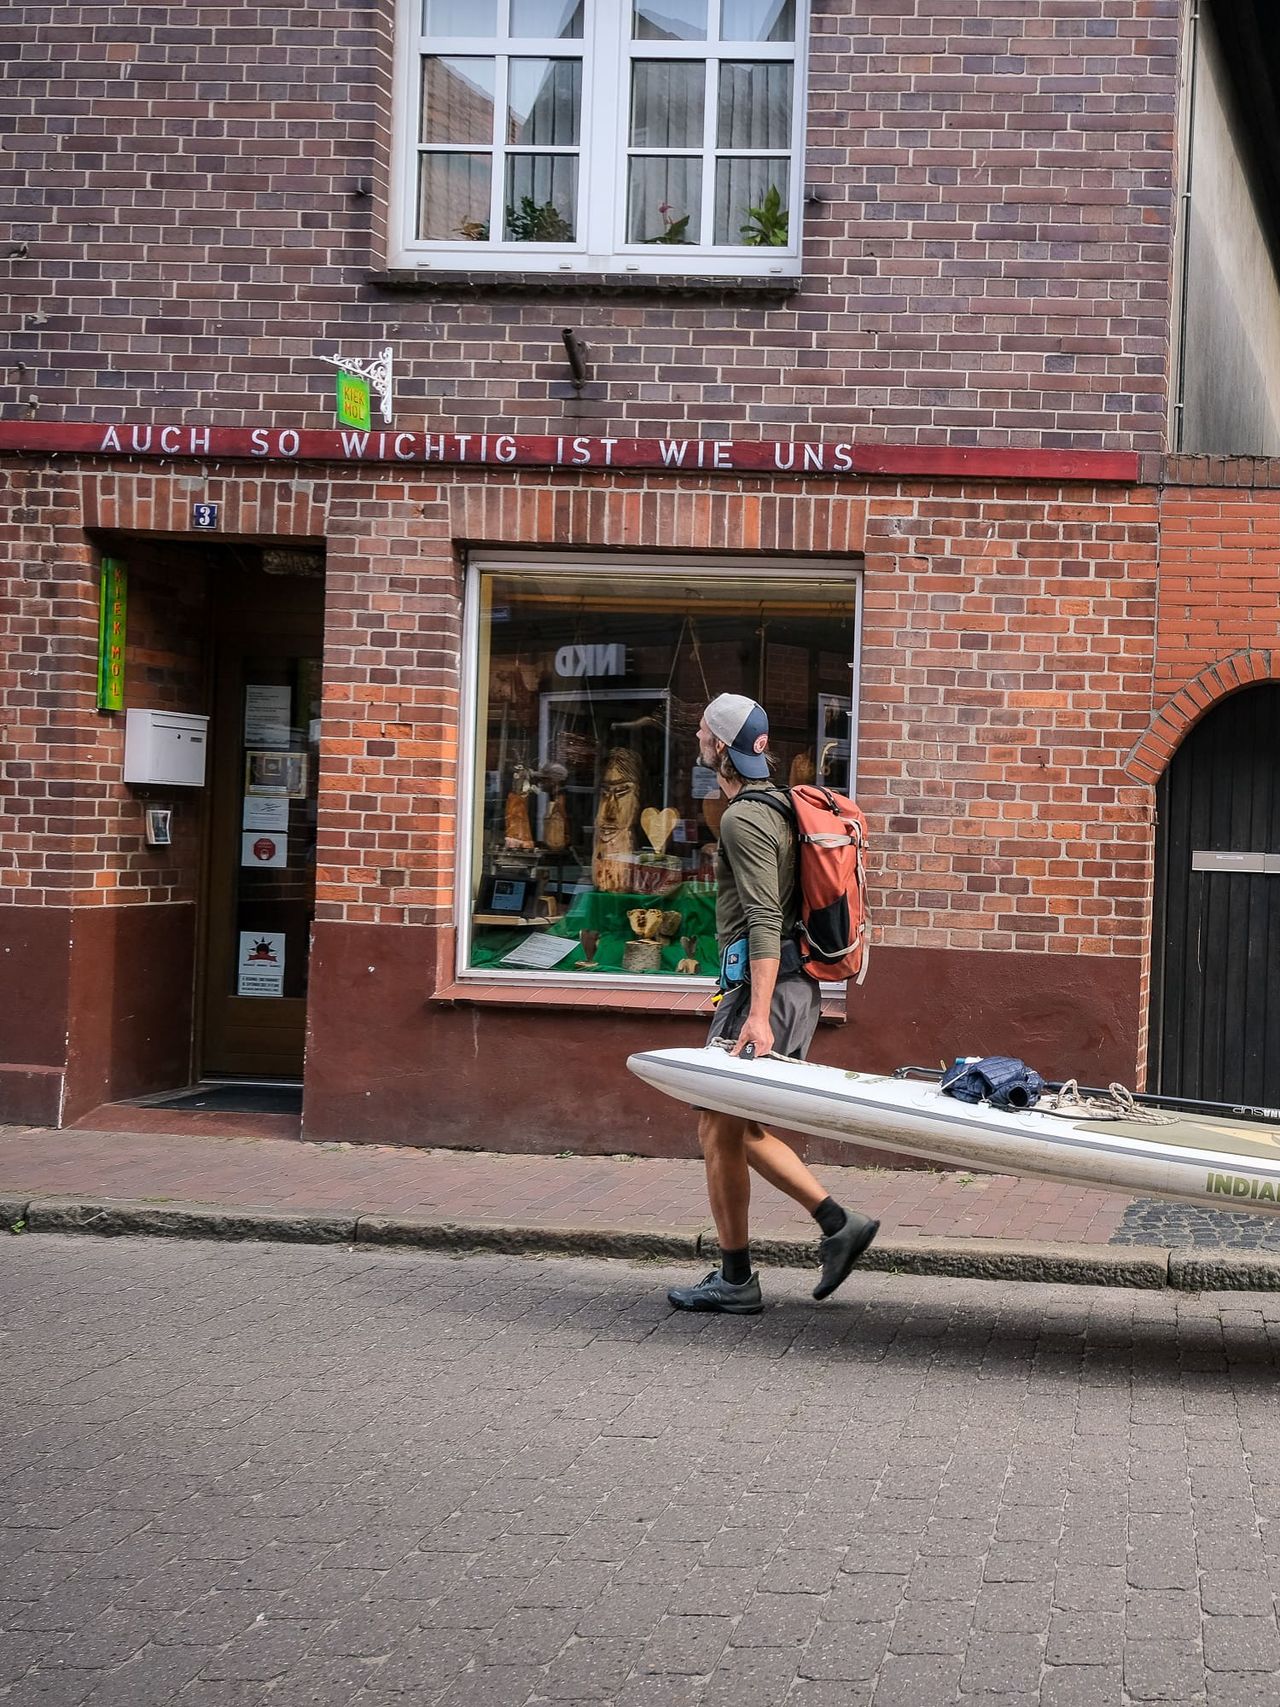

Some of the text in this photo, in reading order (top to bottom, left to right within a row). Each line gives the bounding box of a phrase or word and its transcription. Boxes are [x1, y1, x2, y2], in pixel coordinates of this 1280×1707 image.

[344, 401, 365, 420] MOL
[101, 425, 854, 471] AUCH SO WICHTIG IST WIE UNS
[199, 506, 211, 526] 3
[111, 567, 122, 697] KIEK MOL
